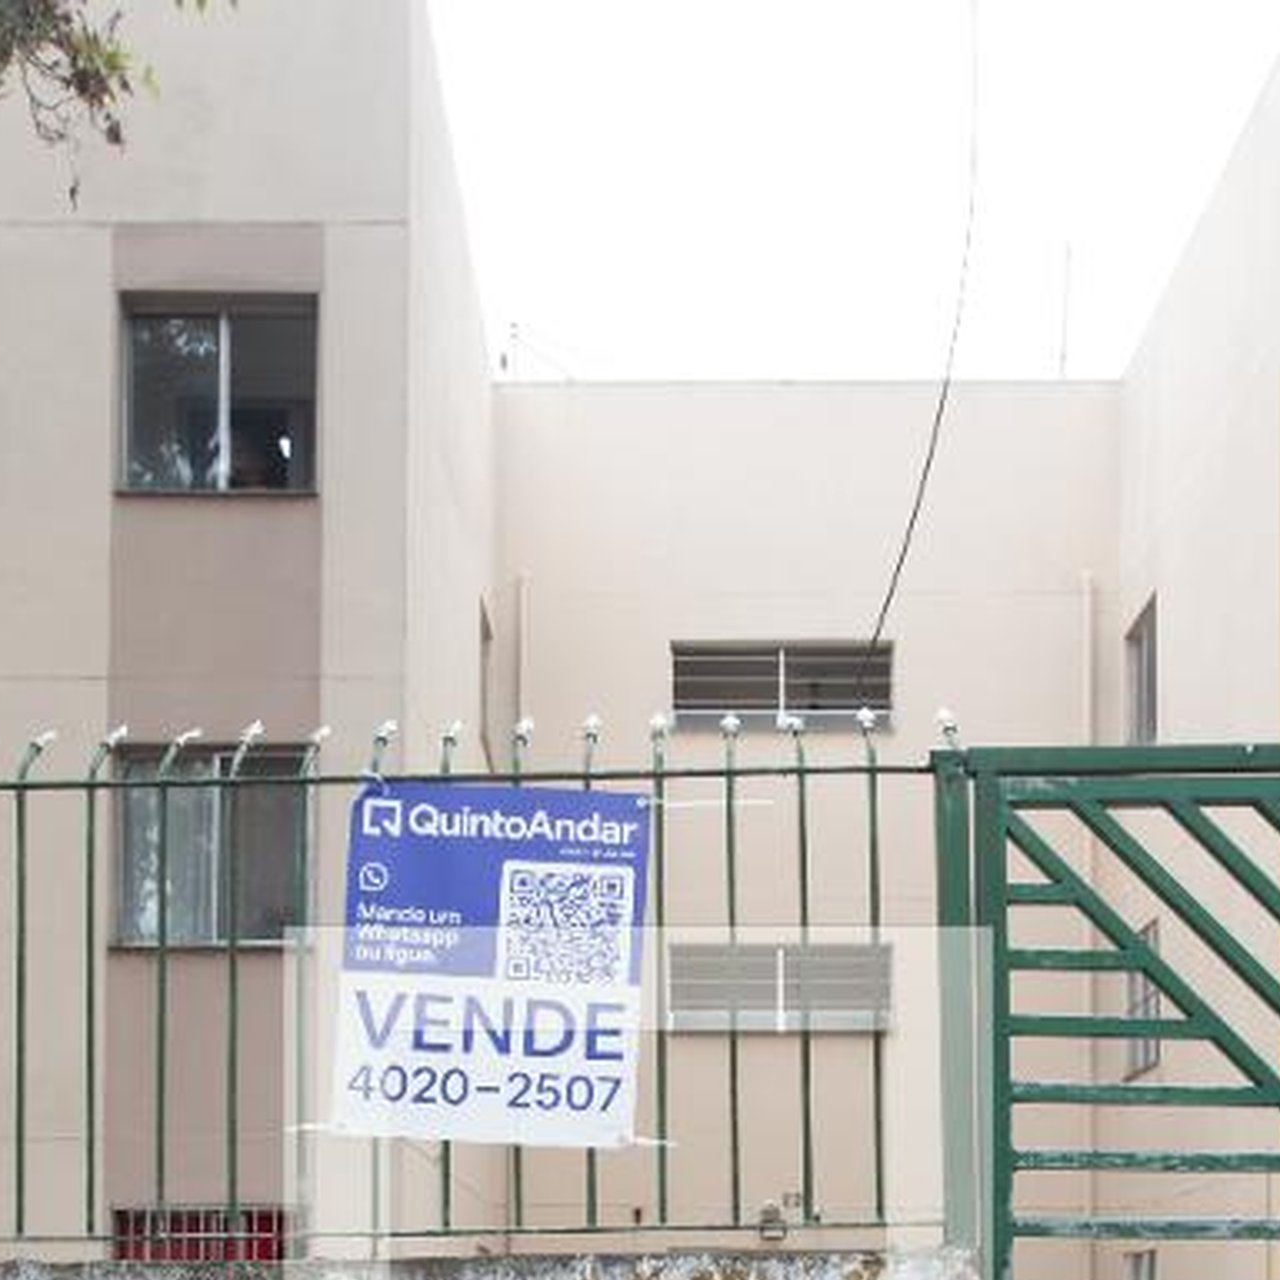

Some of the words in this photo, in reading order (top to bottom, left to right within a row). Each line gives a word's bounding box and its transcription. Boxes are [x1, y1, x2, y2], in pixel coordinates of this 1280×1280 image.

[408, 803, 639, 846] QuintoAndar
[354, 989, 628, 1062] VENDE
[348, 1064, 623, 1113] 4020-2507
